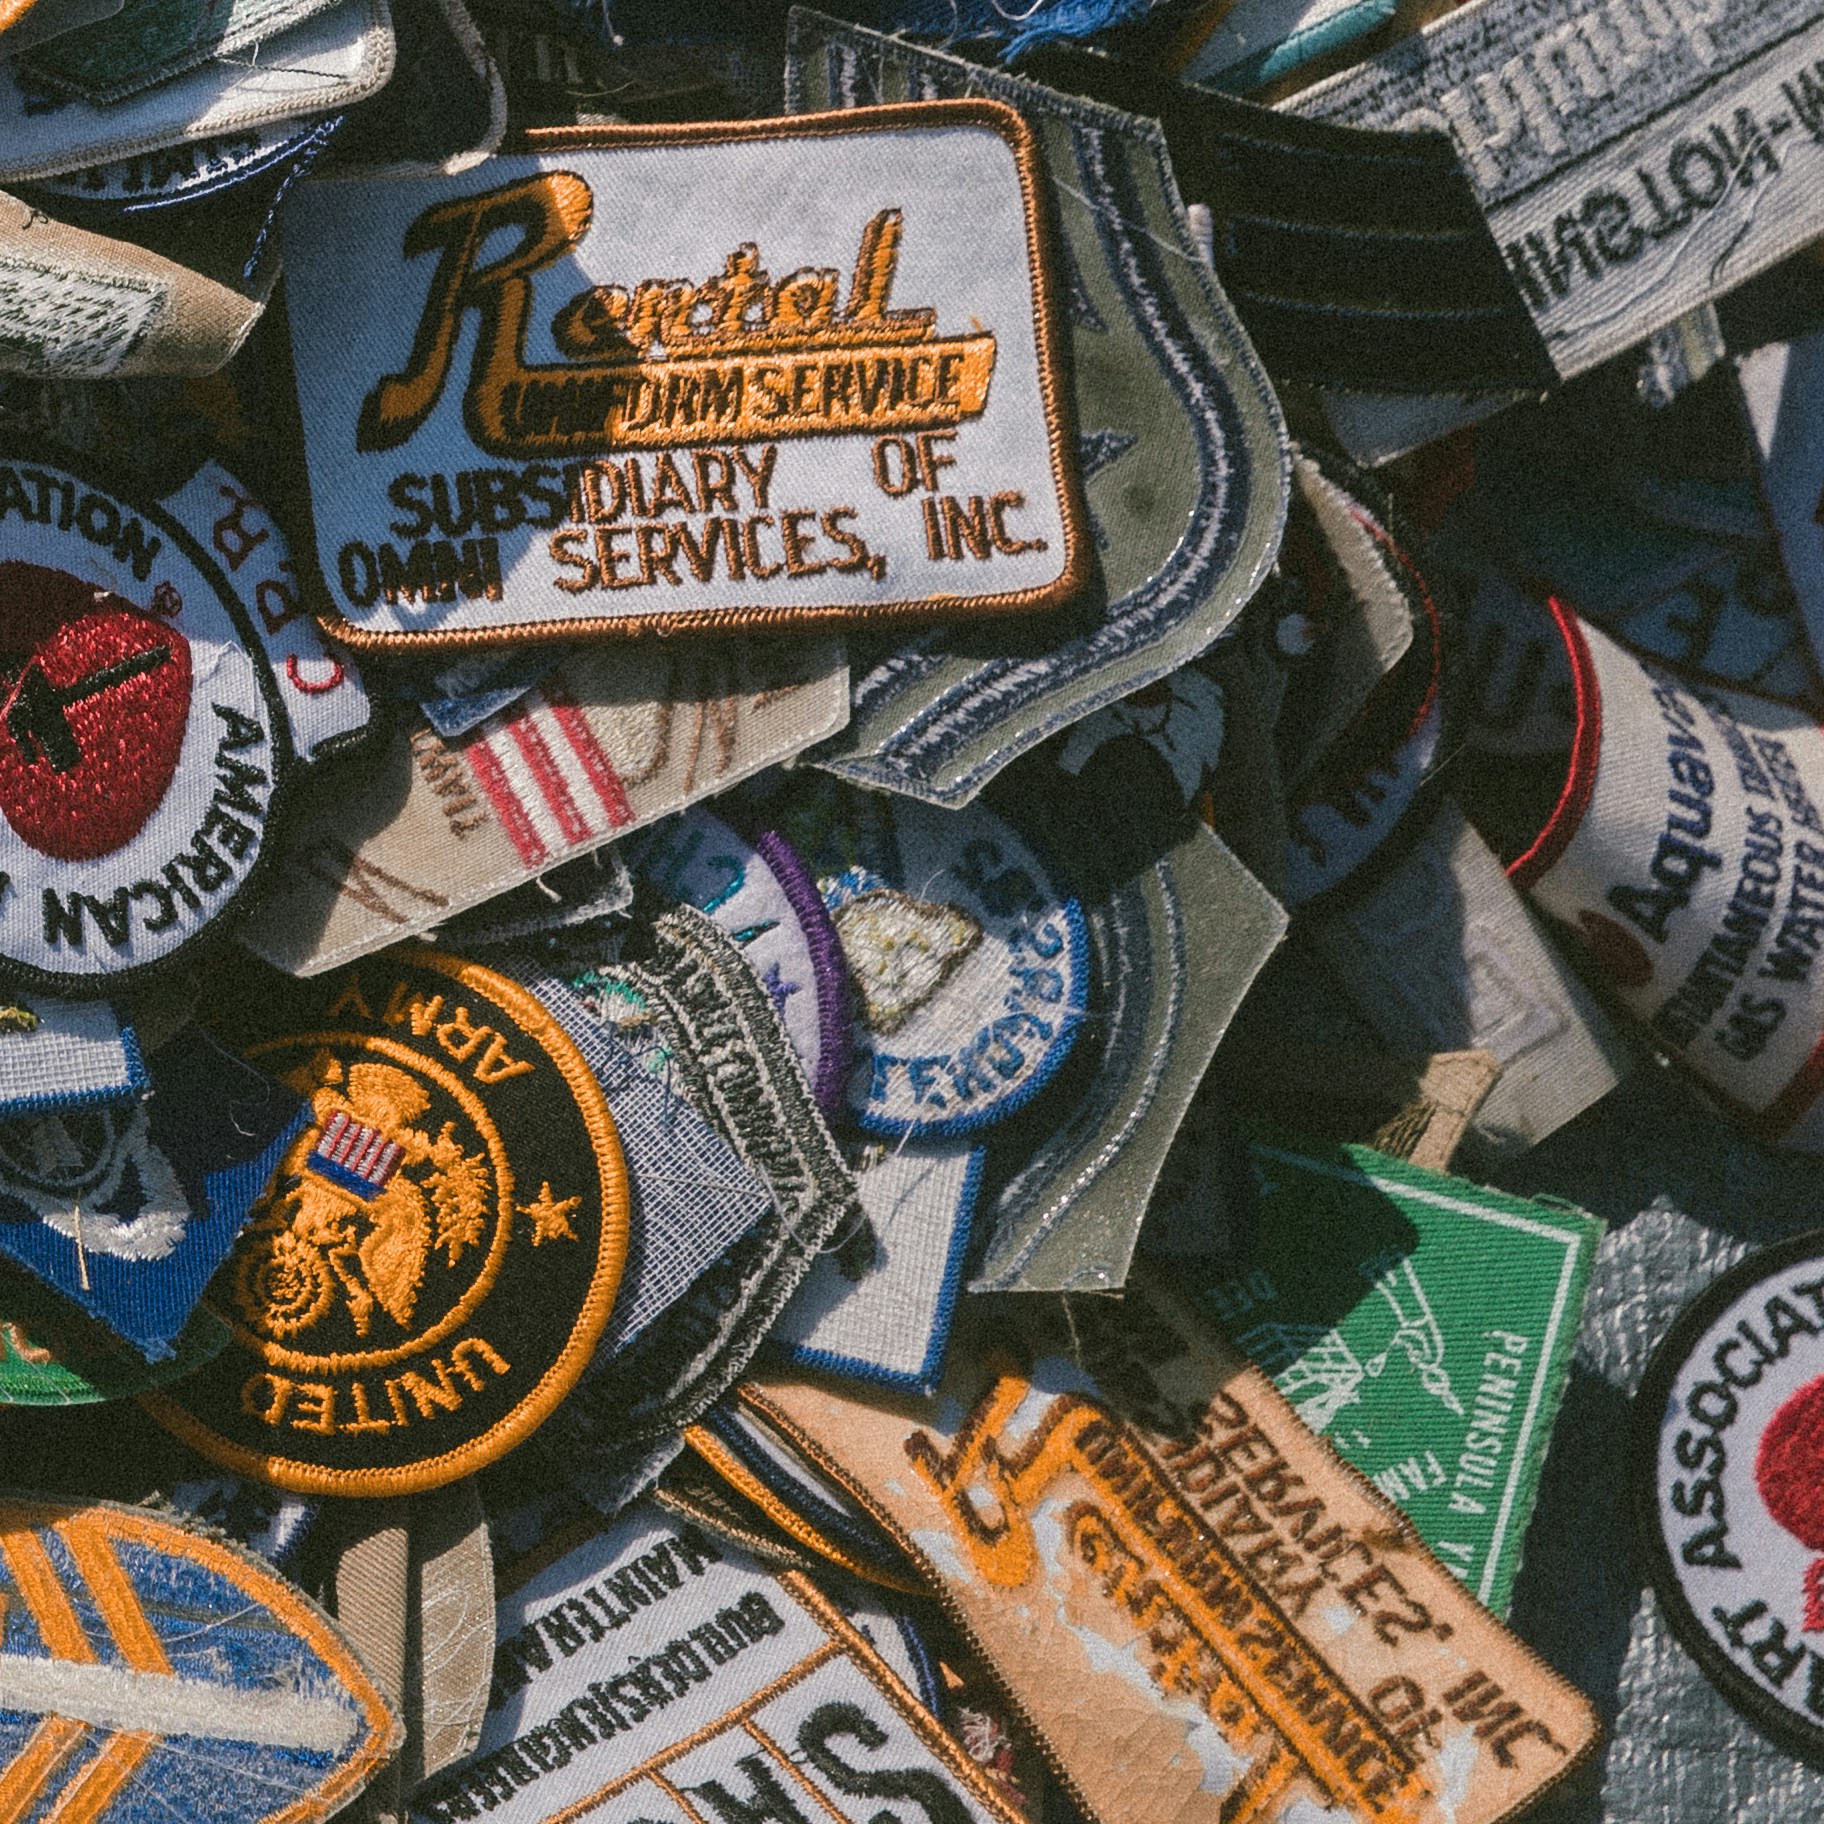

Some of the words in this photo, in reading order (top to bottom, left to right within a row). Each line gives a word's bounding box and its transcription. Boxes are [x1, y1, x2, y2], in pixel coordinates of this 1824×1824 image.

[750, 350, 966, 422] SERVICE
[387, 444, 779, 541] SUBSIDIARY
[871, 430, 959, 498] OF
[336, 537, 503, 608] OMNI
[922, 490, 1050, 562] INC.
[41, 702, 269, 948] AMERICAN
[1450, 1330, 1529, 1516] PENINSULA
